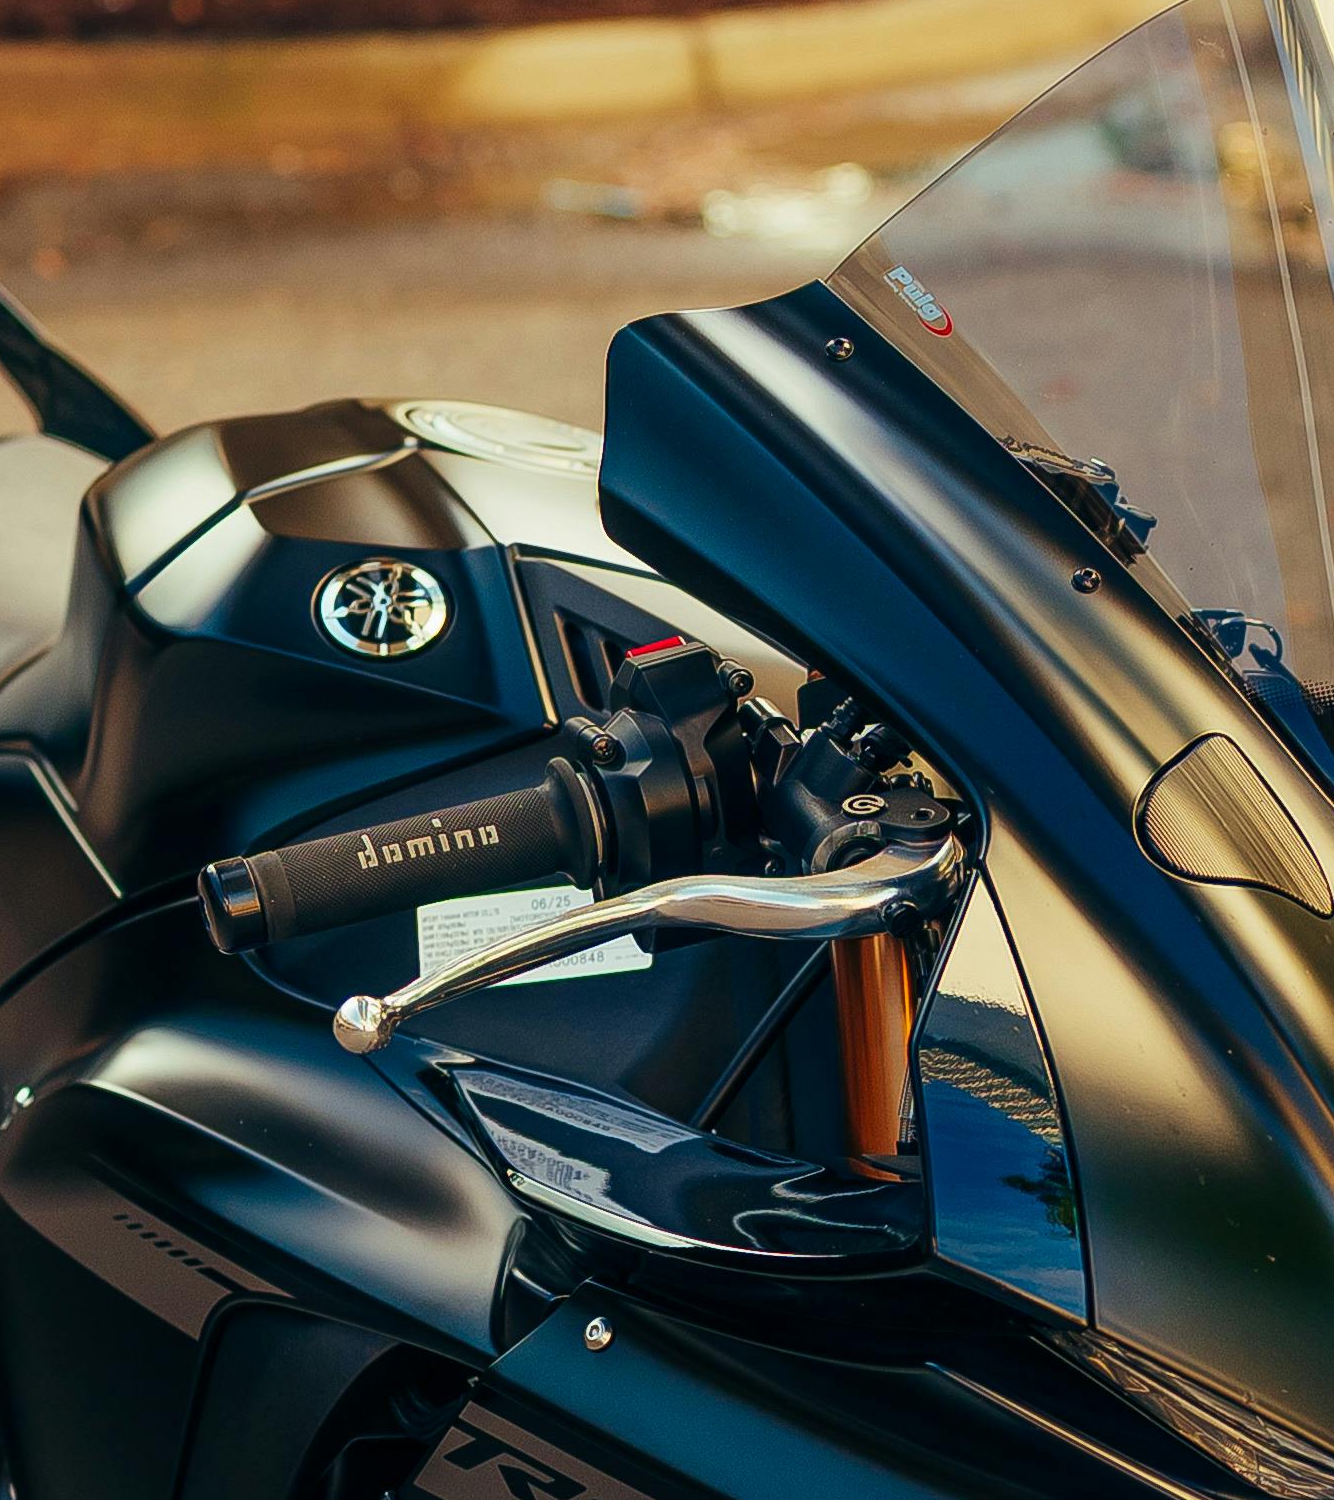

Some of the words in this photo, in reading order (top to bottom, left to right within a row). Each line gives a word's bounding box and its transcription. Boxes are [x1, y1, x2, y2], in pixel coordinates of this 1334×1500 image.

[886, 265, 944, 322] Puig
[357, 817, 500, 870] domino
[531, 895, 571, 910] 06/25
